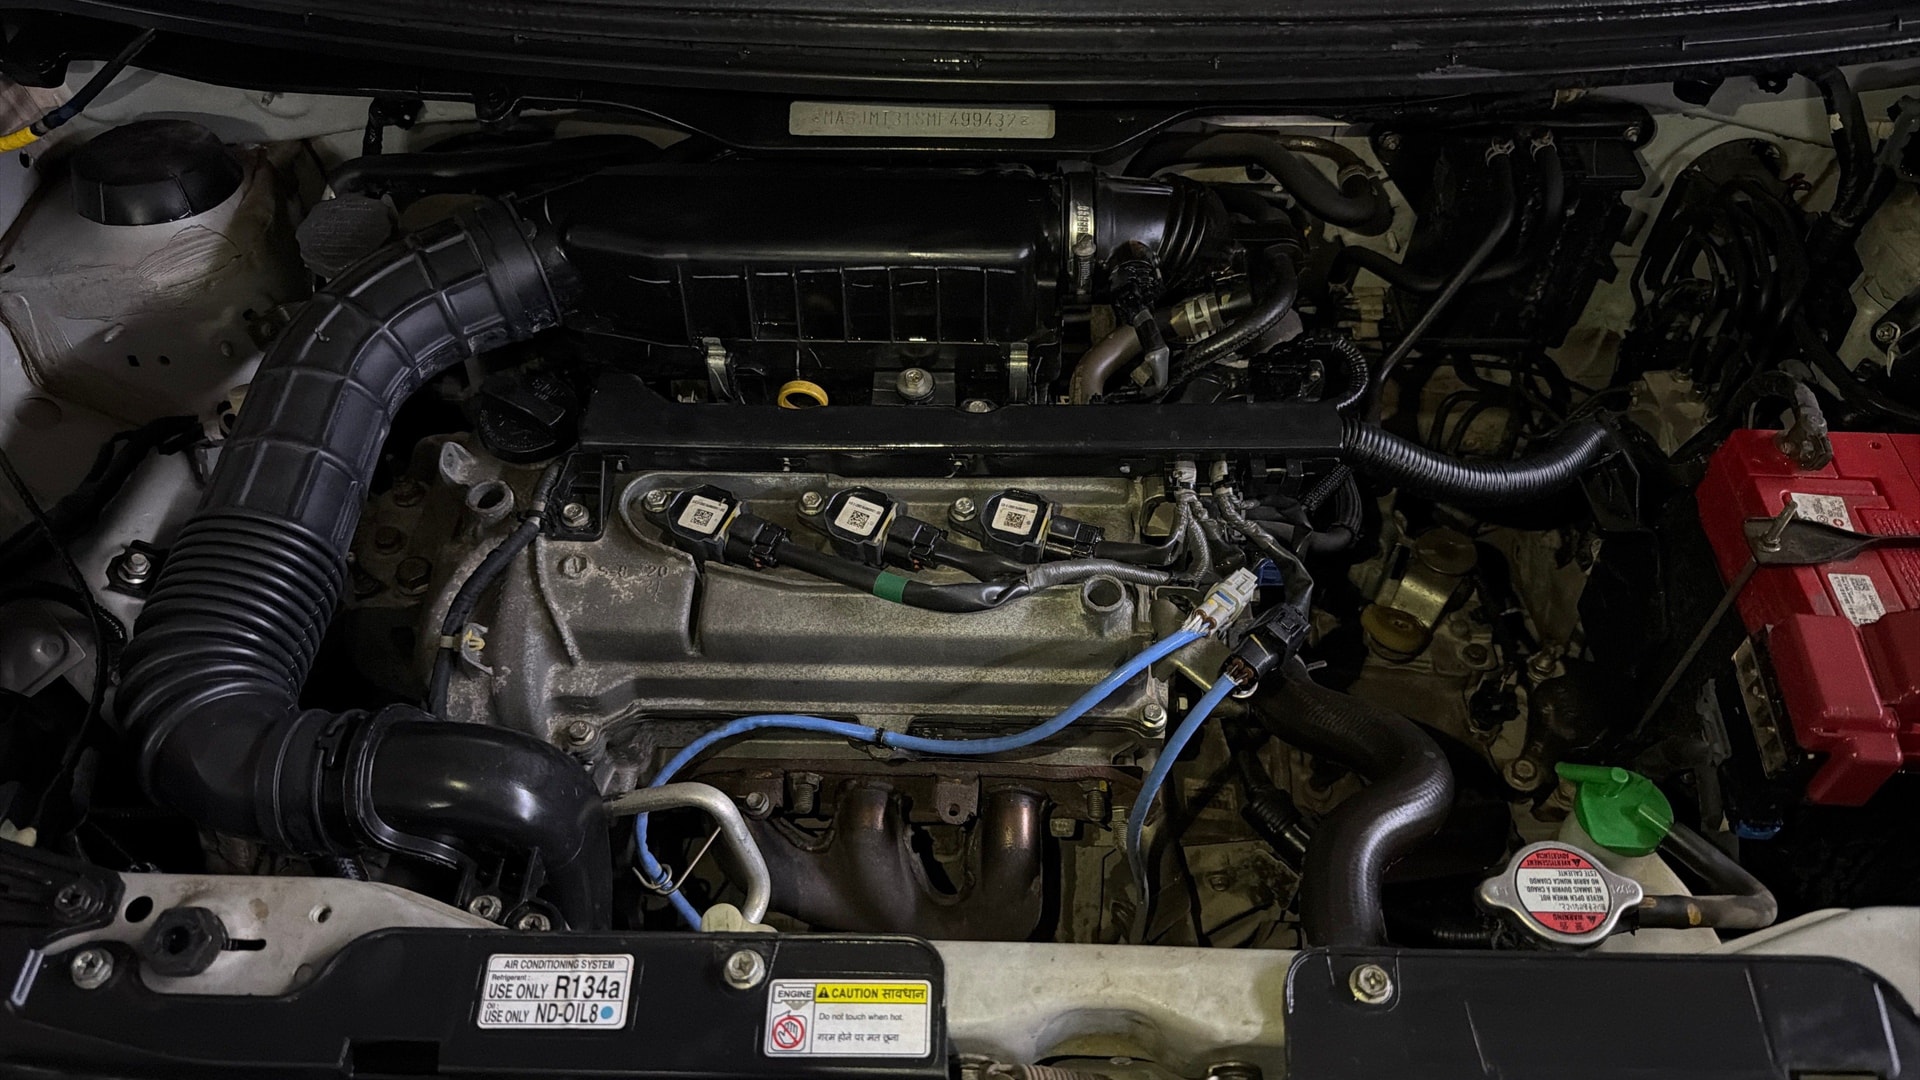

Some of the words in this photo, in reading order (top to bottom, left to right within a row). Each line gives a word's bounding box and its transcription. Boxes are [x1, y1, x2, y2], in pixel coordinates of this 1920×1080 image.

[504, 960, 518, 969] AIR
[521, 960, 579, 969] CONDITIONING
[581, 960, 615, 969] SYSTEM
[489, 984, 513, 998] USE
[516, 984, 549, 998] ONLY
[554, 975, 620, 999] R134a
[778, 990, 812, 998] ENGINE
[831, 988, 878, 998] CAUTION
[882, 988, 925, 999] सावधान
[484, 1011, 503, 1022] USE
[505, 1010, 530, 1022] ONLY
[535, 1003, 599, 1023] ND-OIL8
[817, 1033, 835, 1042] गरम
[837, 1031, 852, 1042] होने
[855, 1033, 864, 1042] पर
[866, 1033, 880, 1042] मत
